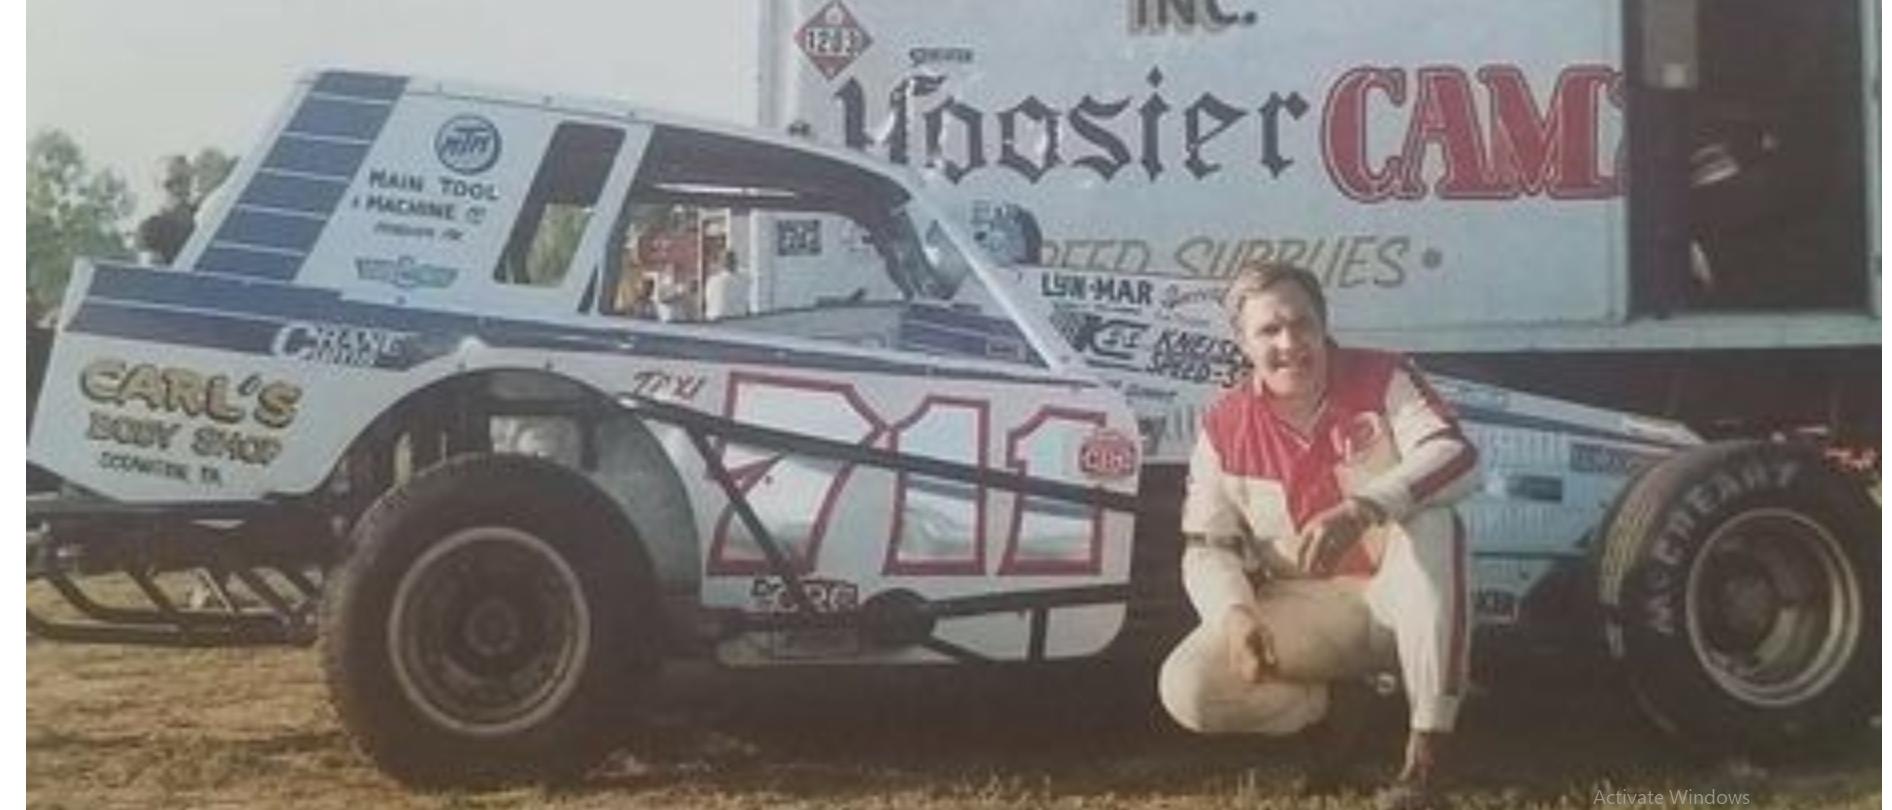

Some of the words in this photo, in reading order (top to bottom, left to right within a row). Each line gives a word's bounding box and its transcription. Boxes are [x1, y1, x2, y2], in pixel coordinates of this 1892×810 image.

[834, 66, 1310, 185] Hoosier
[1319, 64, 1627, 204] CAM
[365, 195, 456, 221] MACHINE
[369, 168, 424, 193] MAIN
[439, 175, 500, 201] TOOL
[80, 358, 303, 428] CARL'S
[87, 411, 182, 449] BODY
[191, 425, 282, 466] SHOP
[706, 370, 1107, 577] 711
